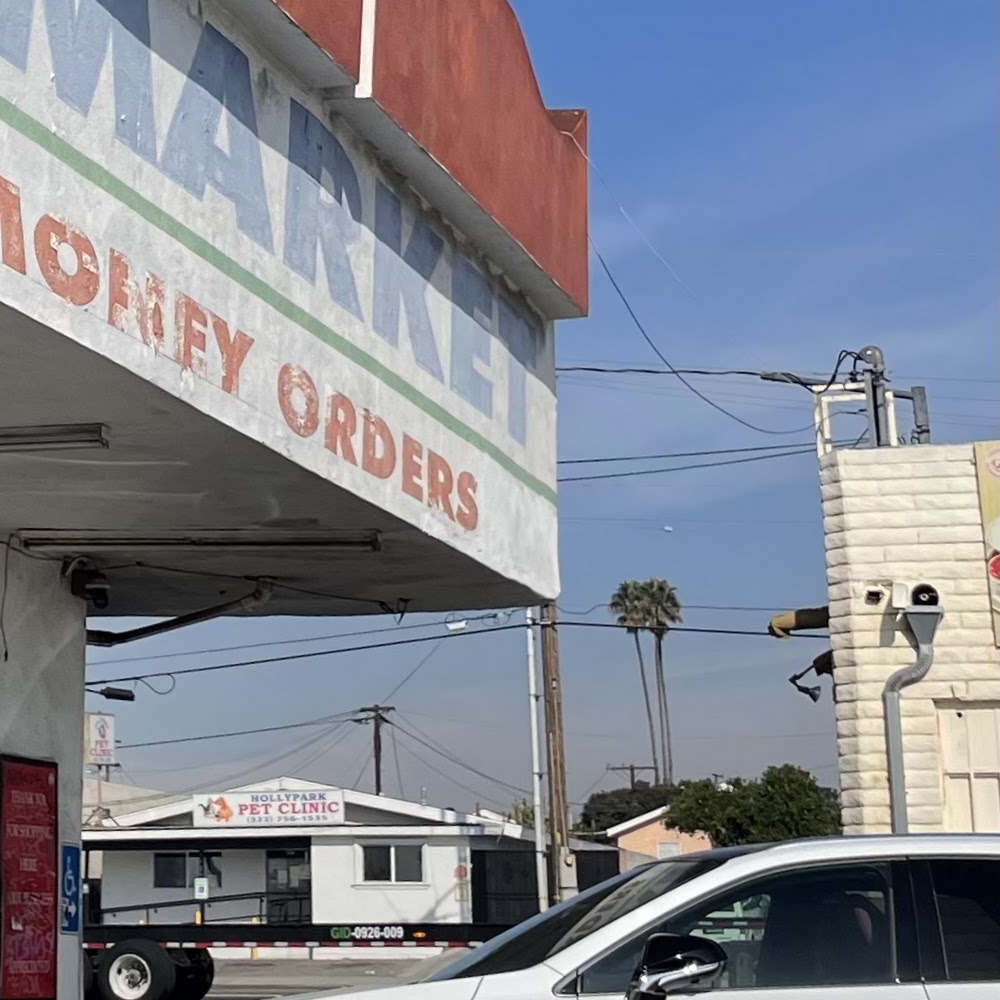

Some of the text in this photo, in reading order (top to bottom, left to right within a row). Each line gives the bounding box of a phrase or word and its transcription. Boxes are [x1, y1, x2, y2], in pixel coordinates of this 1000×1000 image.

[277, 362, 480, 532] ORDERS
[251, 793, 327, 802] HOLLYPARK
[238, 802, 340, 815] PET CLINIC
[330, 926, 404, 939] GID-0926-009
